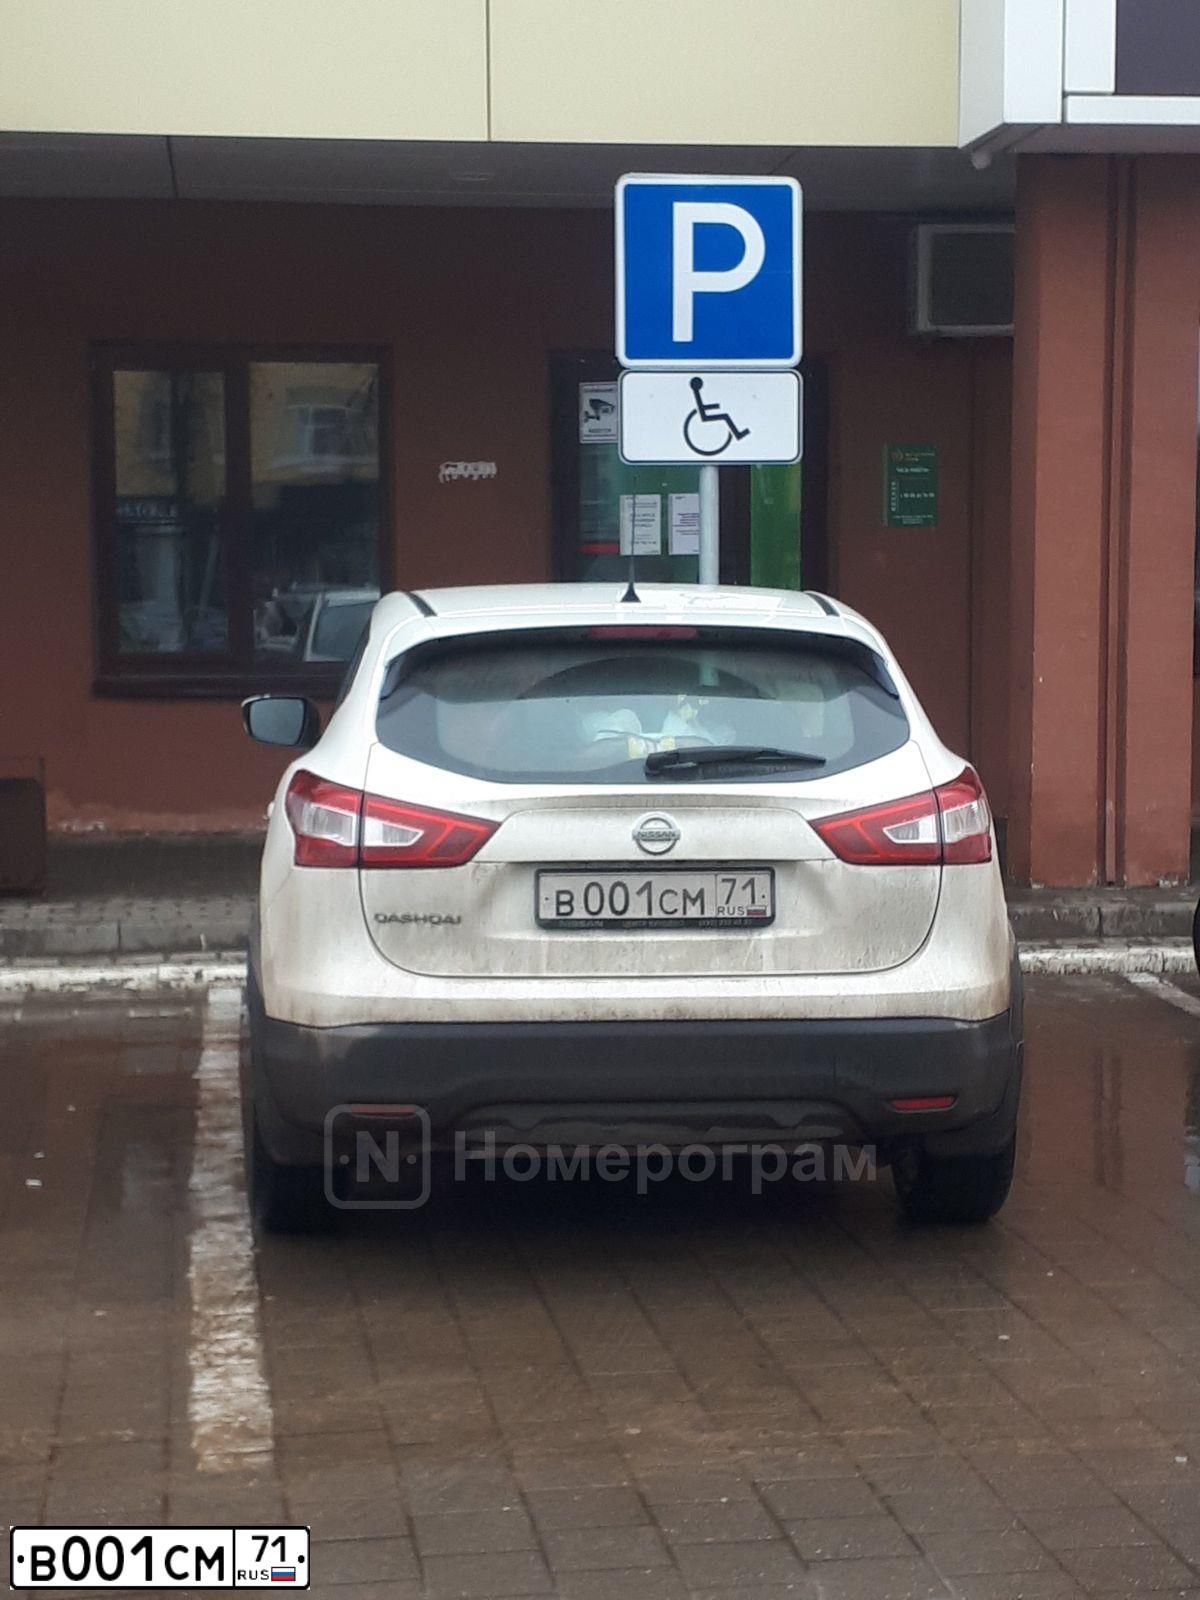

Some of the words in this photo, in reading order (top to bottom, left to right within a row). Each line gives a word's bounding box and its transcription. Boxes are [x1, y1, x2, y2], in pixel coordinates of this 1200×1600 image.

[672, 202, 766, 342] P
[637, 830, 676, 839] NISSAN
[555, 880, 705, 917] В001СМ
[720, 877, 757, 904] 71
[716, 905, 745, 917] RUS
